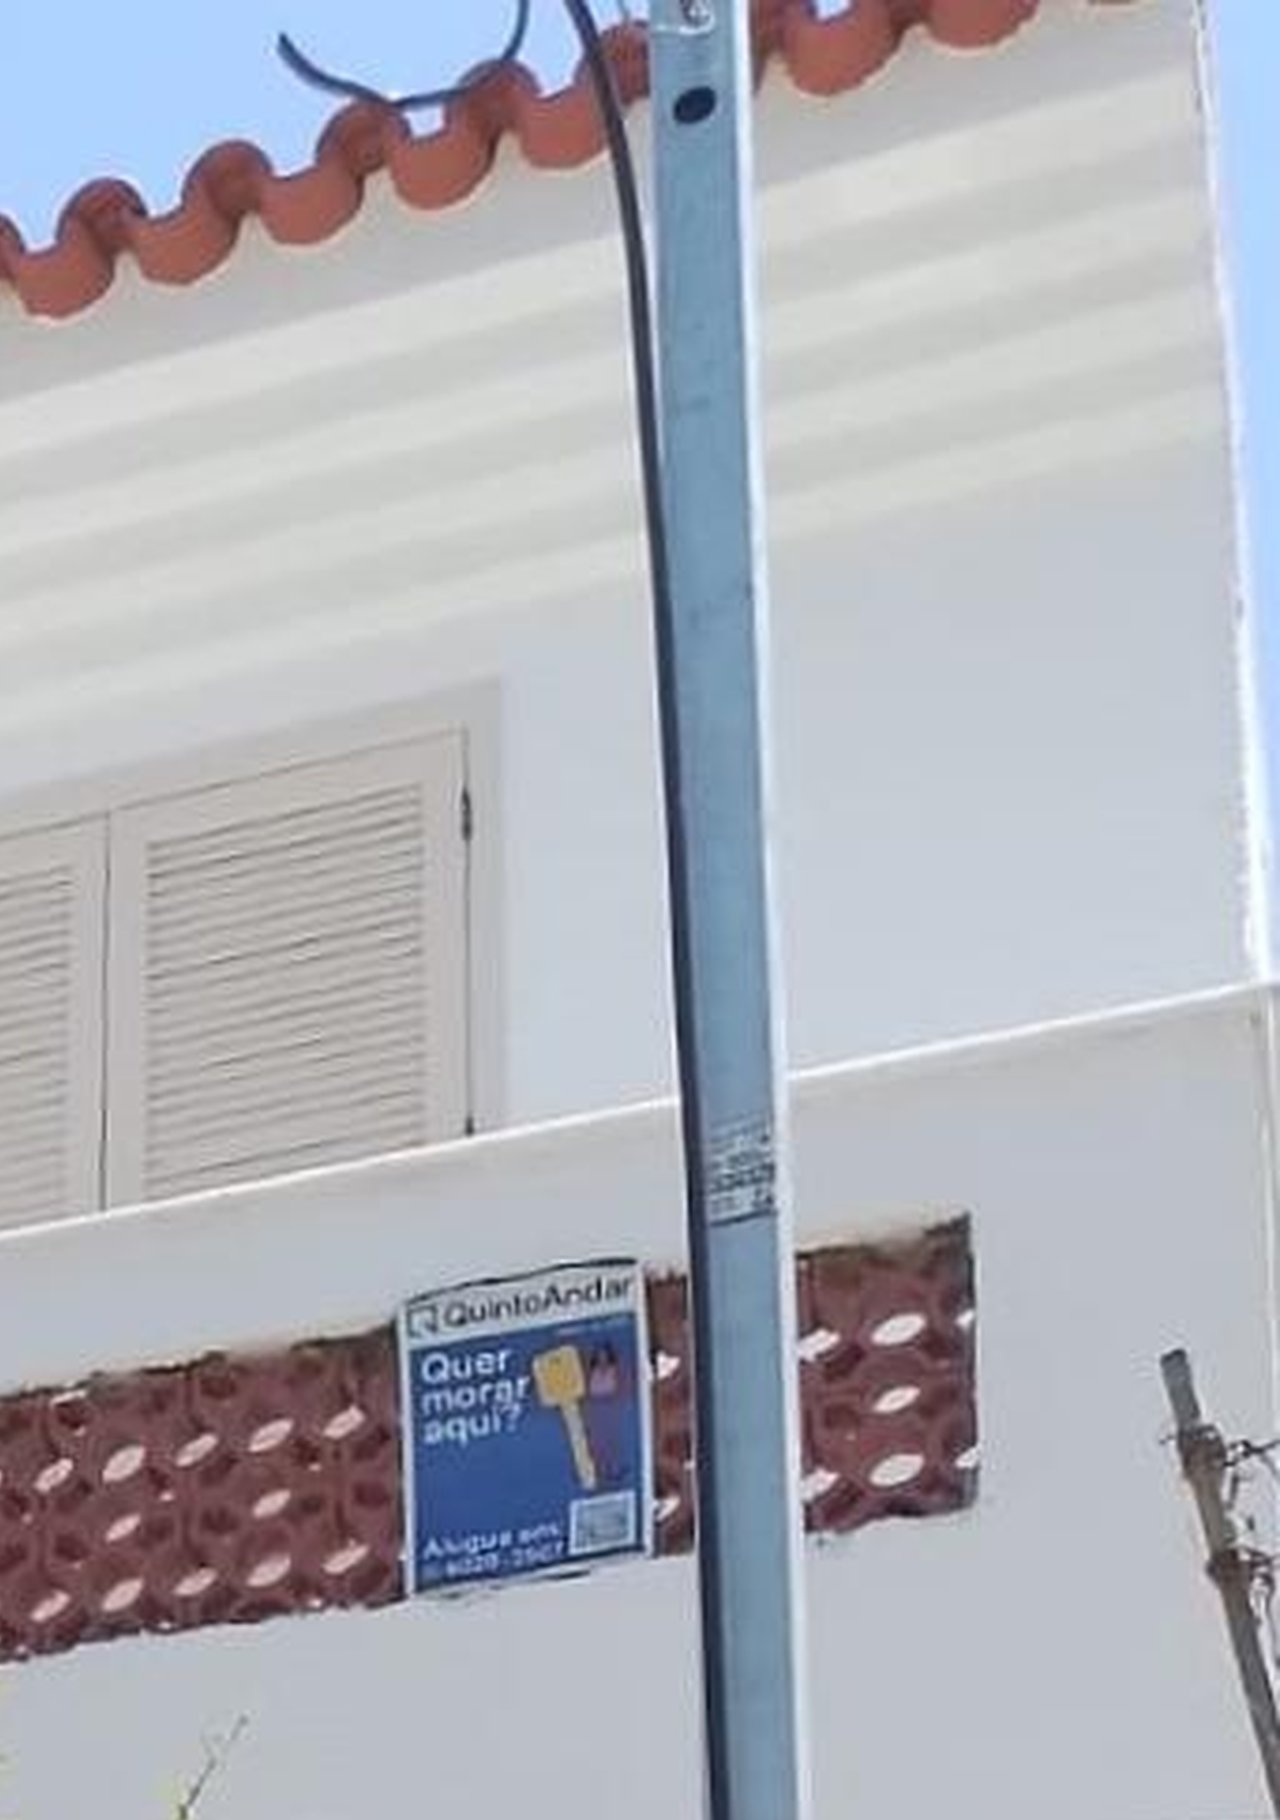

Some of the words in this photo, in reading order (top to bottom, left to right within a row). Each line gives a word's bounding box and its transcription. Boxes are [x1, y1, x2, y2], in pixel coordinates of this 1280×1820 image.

[444, 1277, 630, 1325] QuintoAndar
[422, 1349, 511, 1384] Quer
[422, 1376, 530, 1414] morar
[424, 1404, 521, 1446] aqui?
